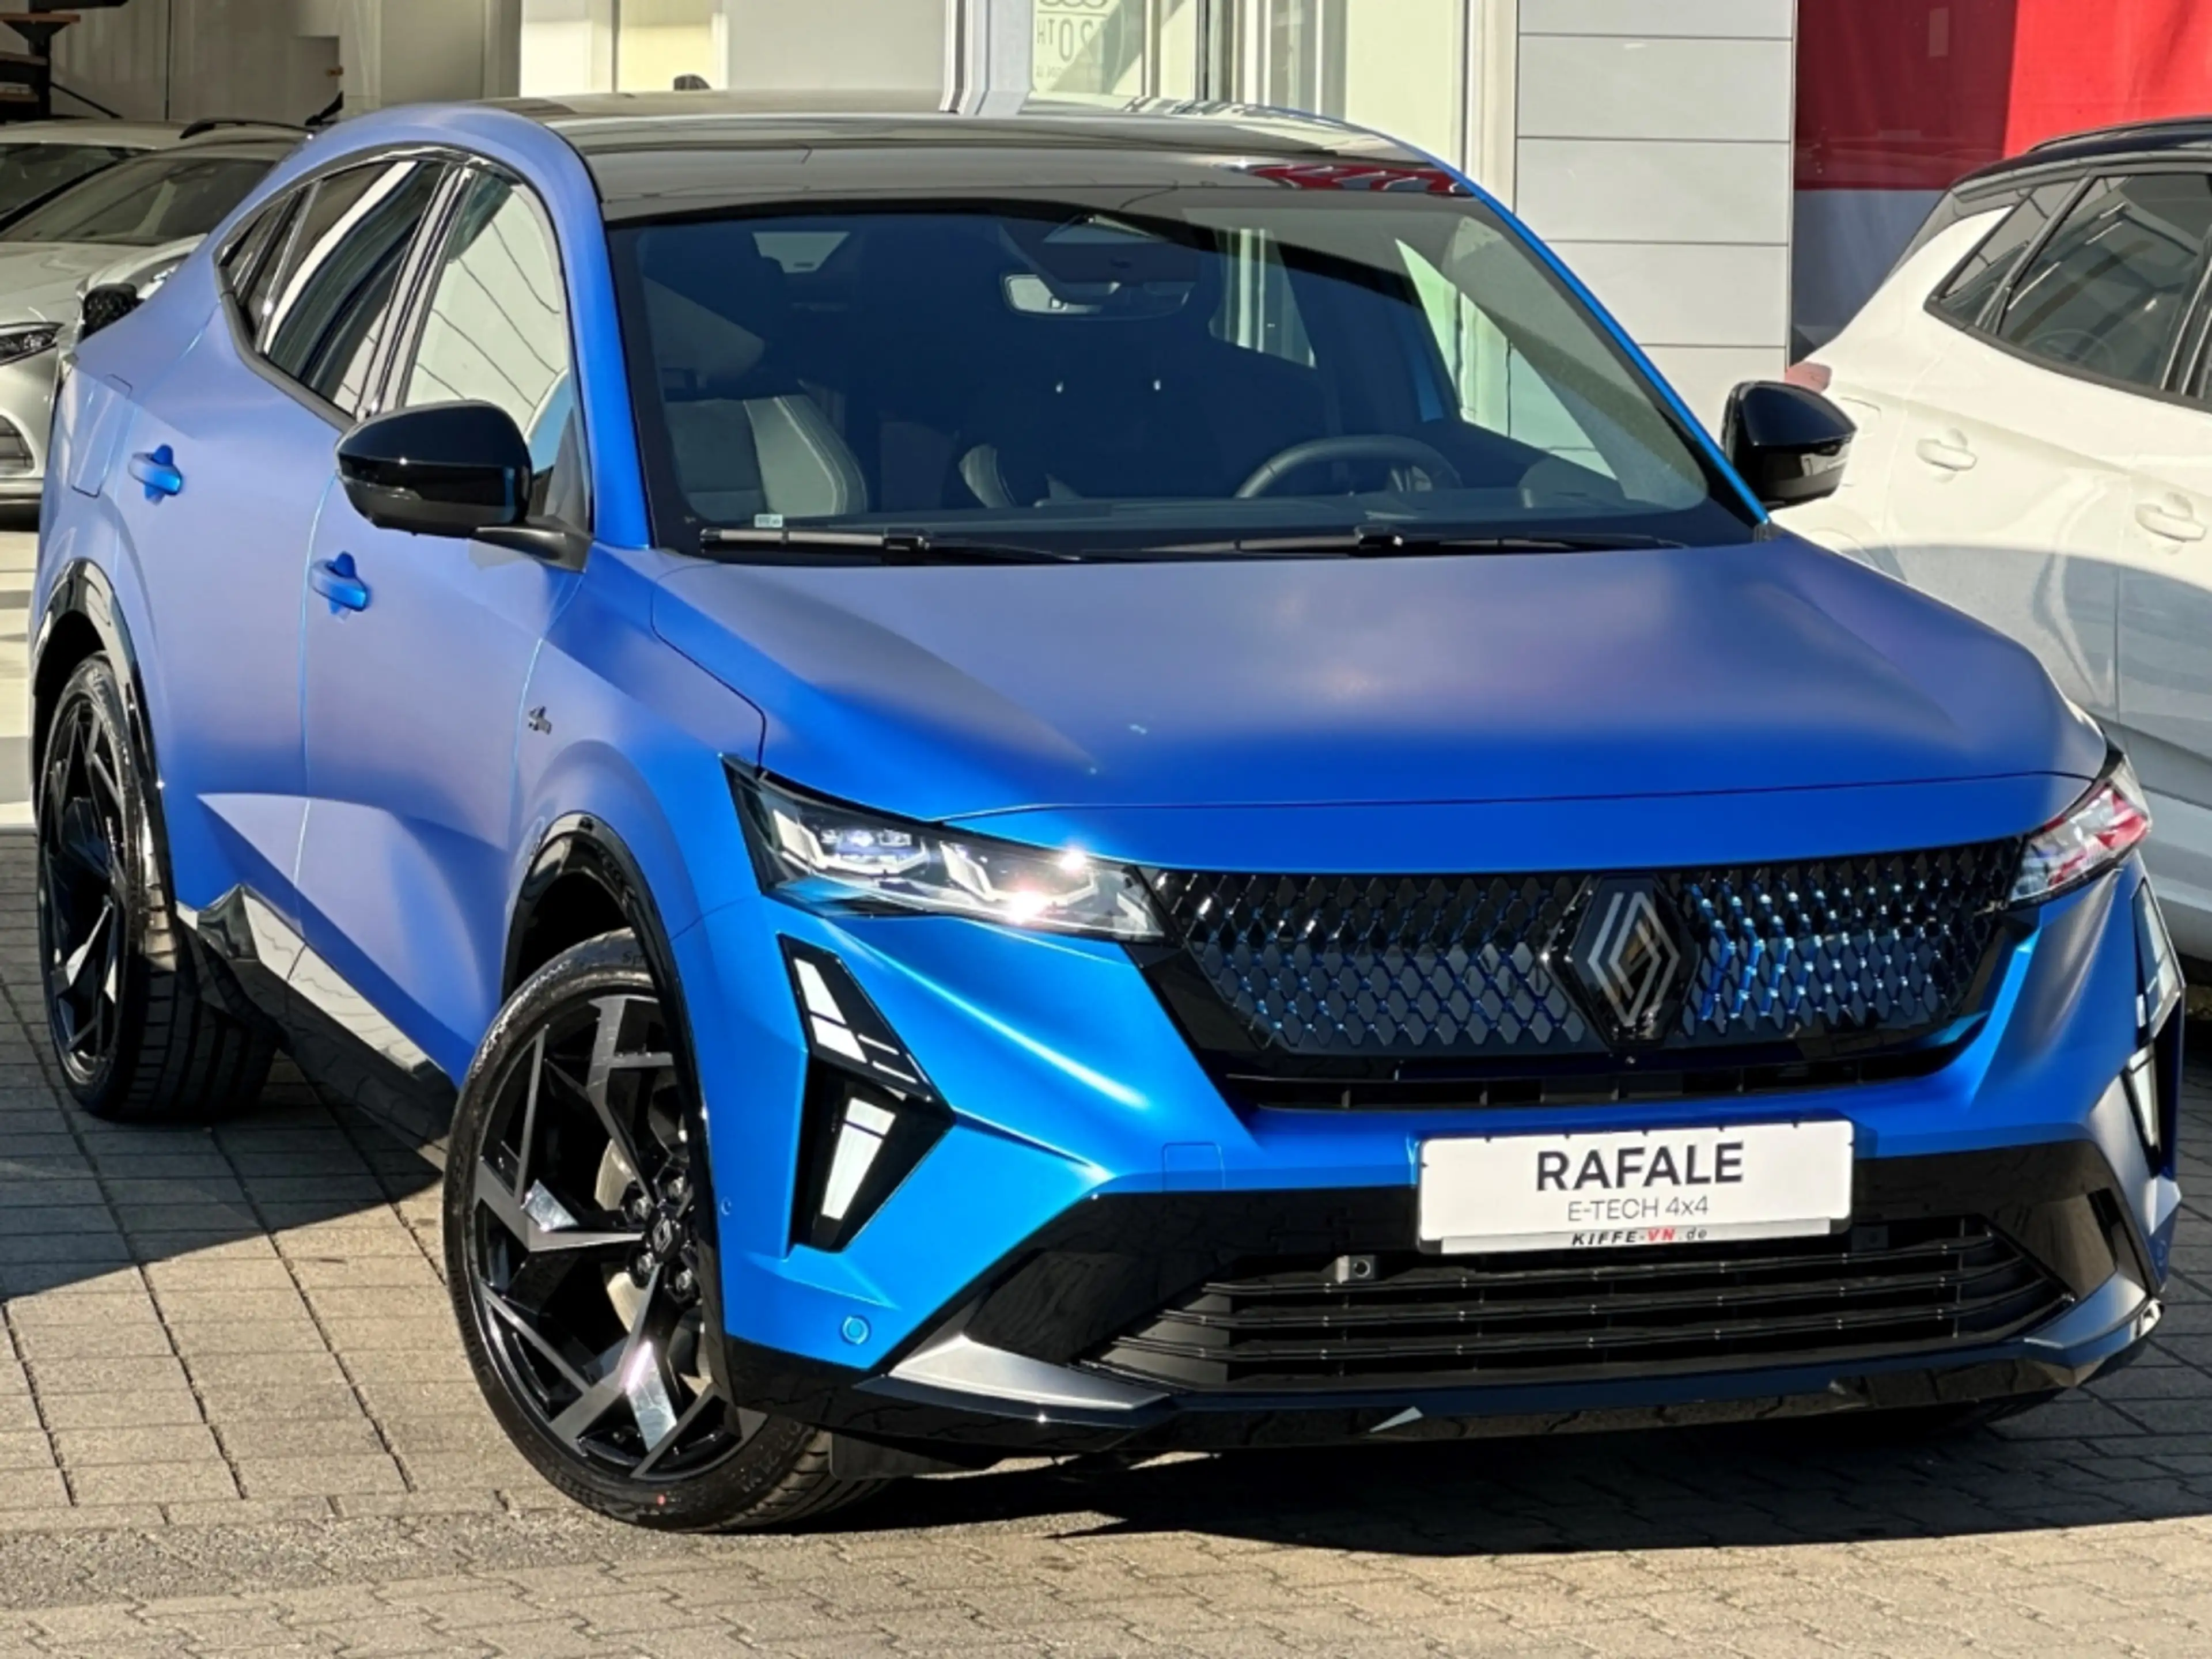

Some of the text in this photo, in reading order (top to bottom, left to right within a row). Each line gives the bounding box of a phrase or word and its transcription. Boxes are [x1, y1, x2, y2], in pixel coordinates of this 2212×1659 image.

[1537, 1141, 1743, 1191] RAFALE
[1568, 1195, 1709, 1221] E-TECH 4x4
[1571, 1226, 1708, 1245] KIFFE-VN.de
